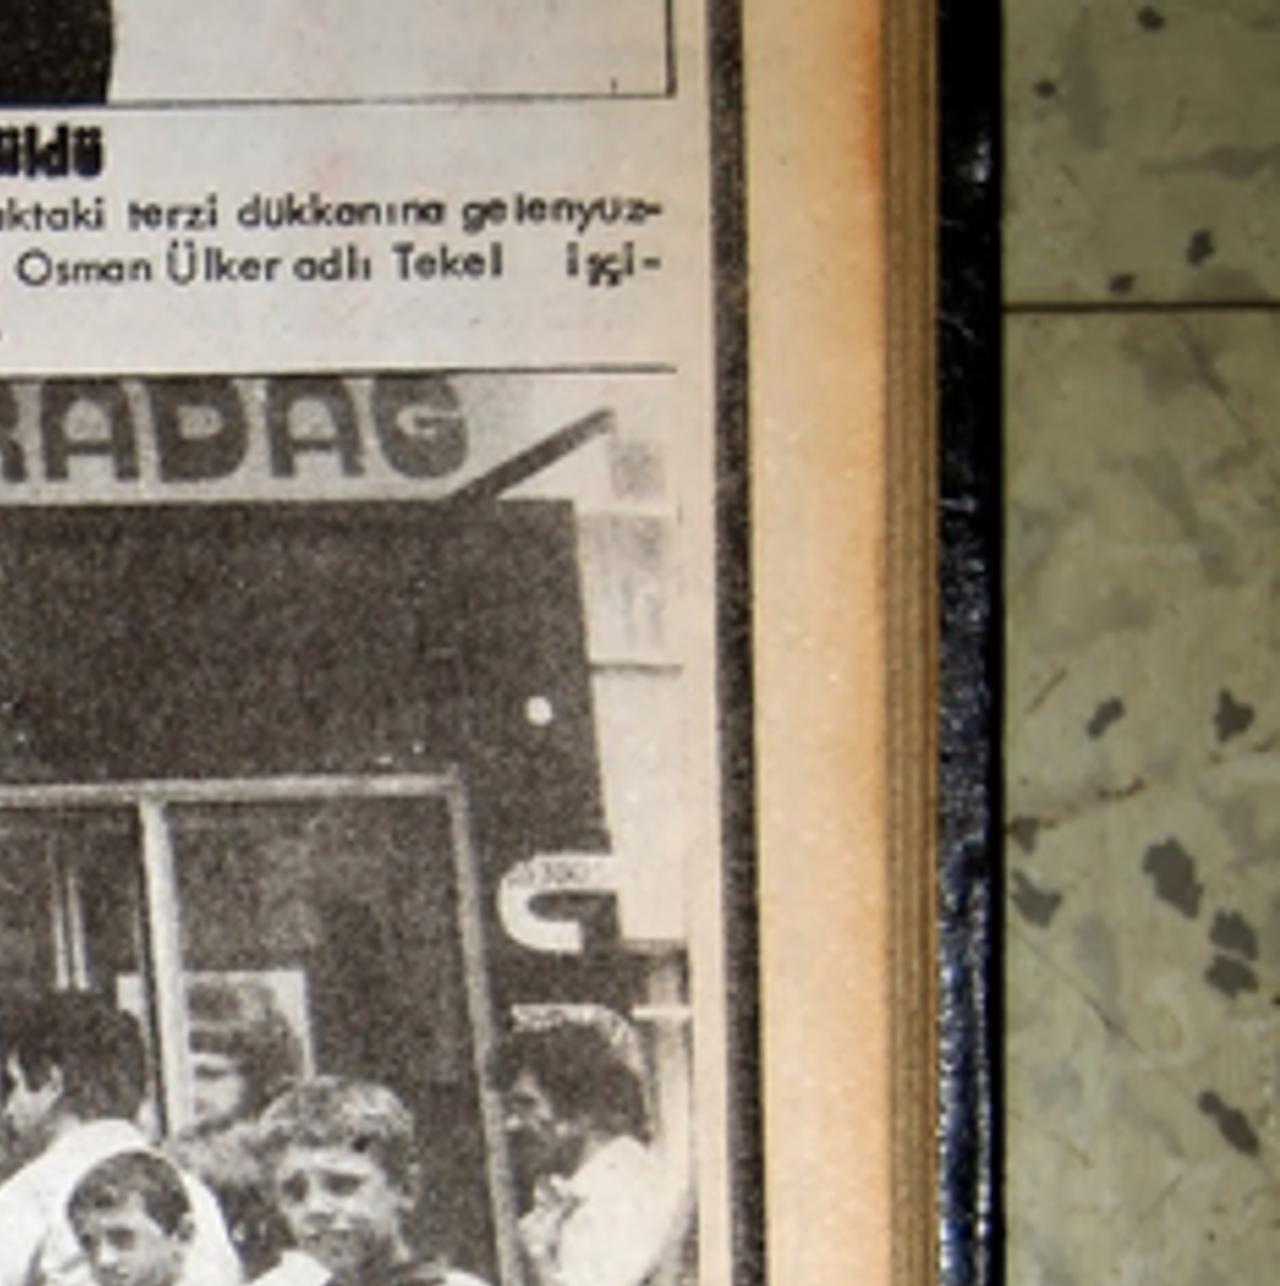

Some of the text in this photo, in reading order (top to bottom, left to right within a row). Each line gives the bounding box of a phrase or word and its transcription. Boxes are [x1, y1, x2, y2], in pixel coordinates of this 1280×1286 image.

[127, 192, 218, 231] terzi
[237, 192, 448, 229] dükkanına
[15, 247, 153, 288] Osman
[166, 238, 283, 286] Ülker
[292, 242, 372, 282] adlı
[392, 241, 504, 281] Tekel
